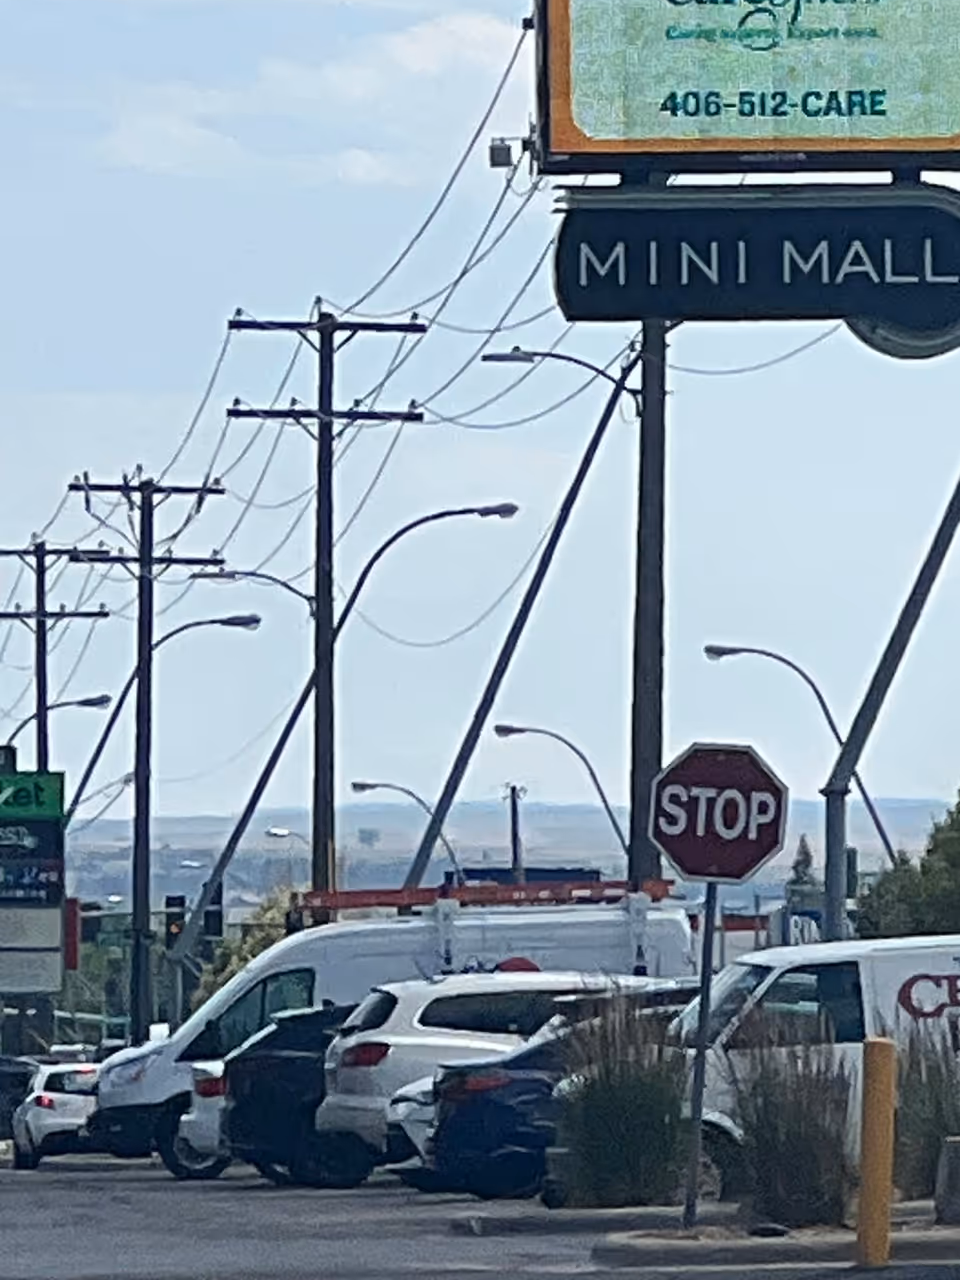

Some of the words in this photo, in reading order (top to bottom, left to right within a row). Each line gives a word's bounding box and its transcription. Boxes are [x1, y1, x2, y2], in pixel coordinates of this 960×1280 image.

[660, 89, 887, 117] 406-512-CARE
[578, 240, 746, 286] MINI
[783, 237, 960, 284] MALL
[658, 784, 776, 840] STOP
